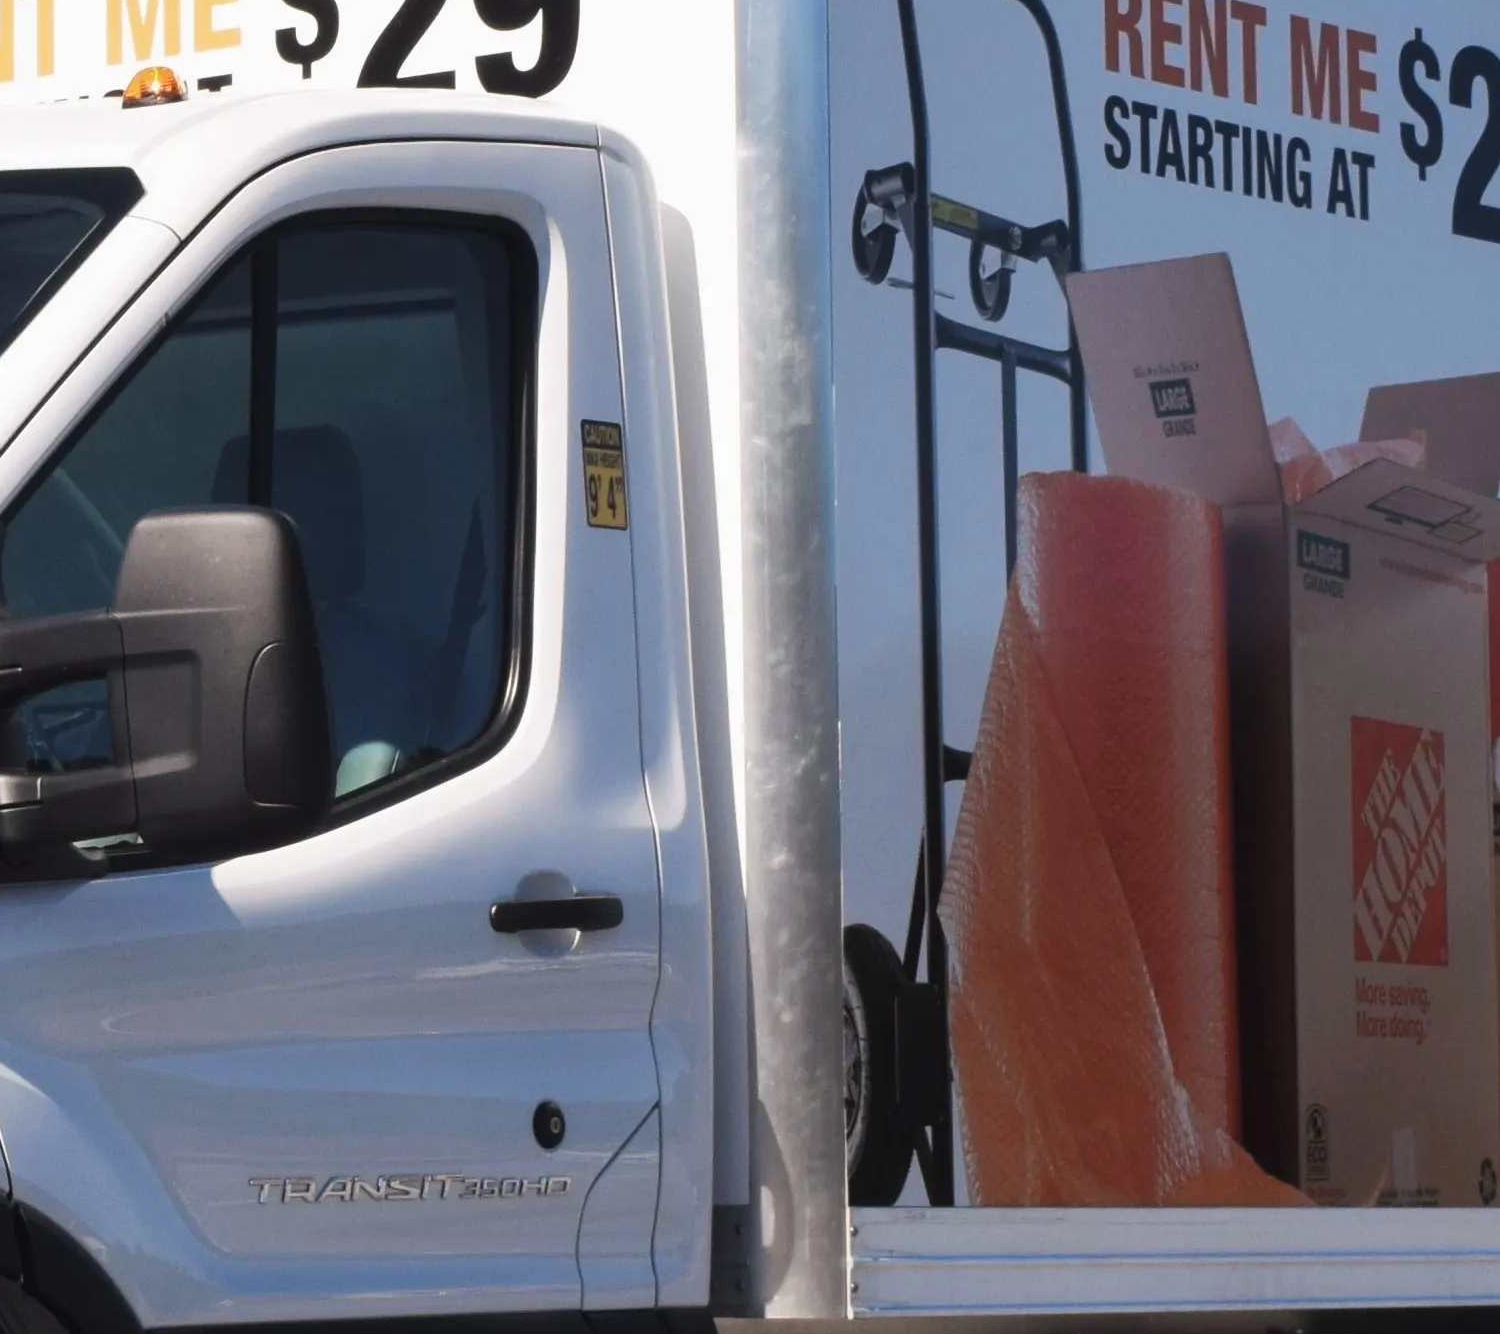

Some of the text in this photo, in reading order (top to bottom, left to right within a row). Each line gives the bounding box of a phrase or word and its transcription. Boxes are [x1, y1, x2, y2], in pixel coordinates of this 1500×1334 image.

[1290, 13, 1380, 134] ME
[1103, 94, 1376, 222] STARTING AT
[584, 423, 621, 447] CAUTION
[1355, 727, 1446, 963] HOME
[1361, 747, 1401, 842] THE
[1391, 817, 1446, 964] DEPOT
[247, 1173, 573, 1205] TRANSIT 350HD
